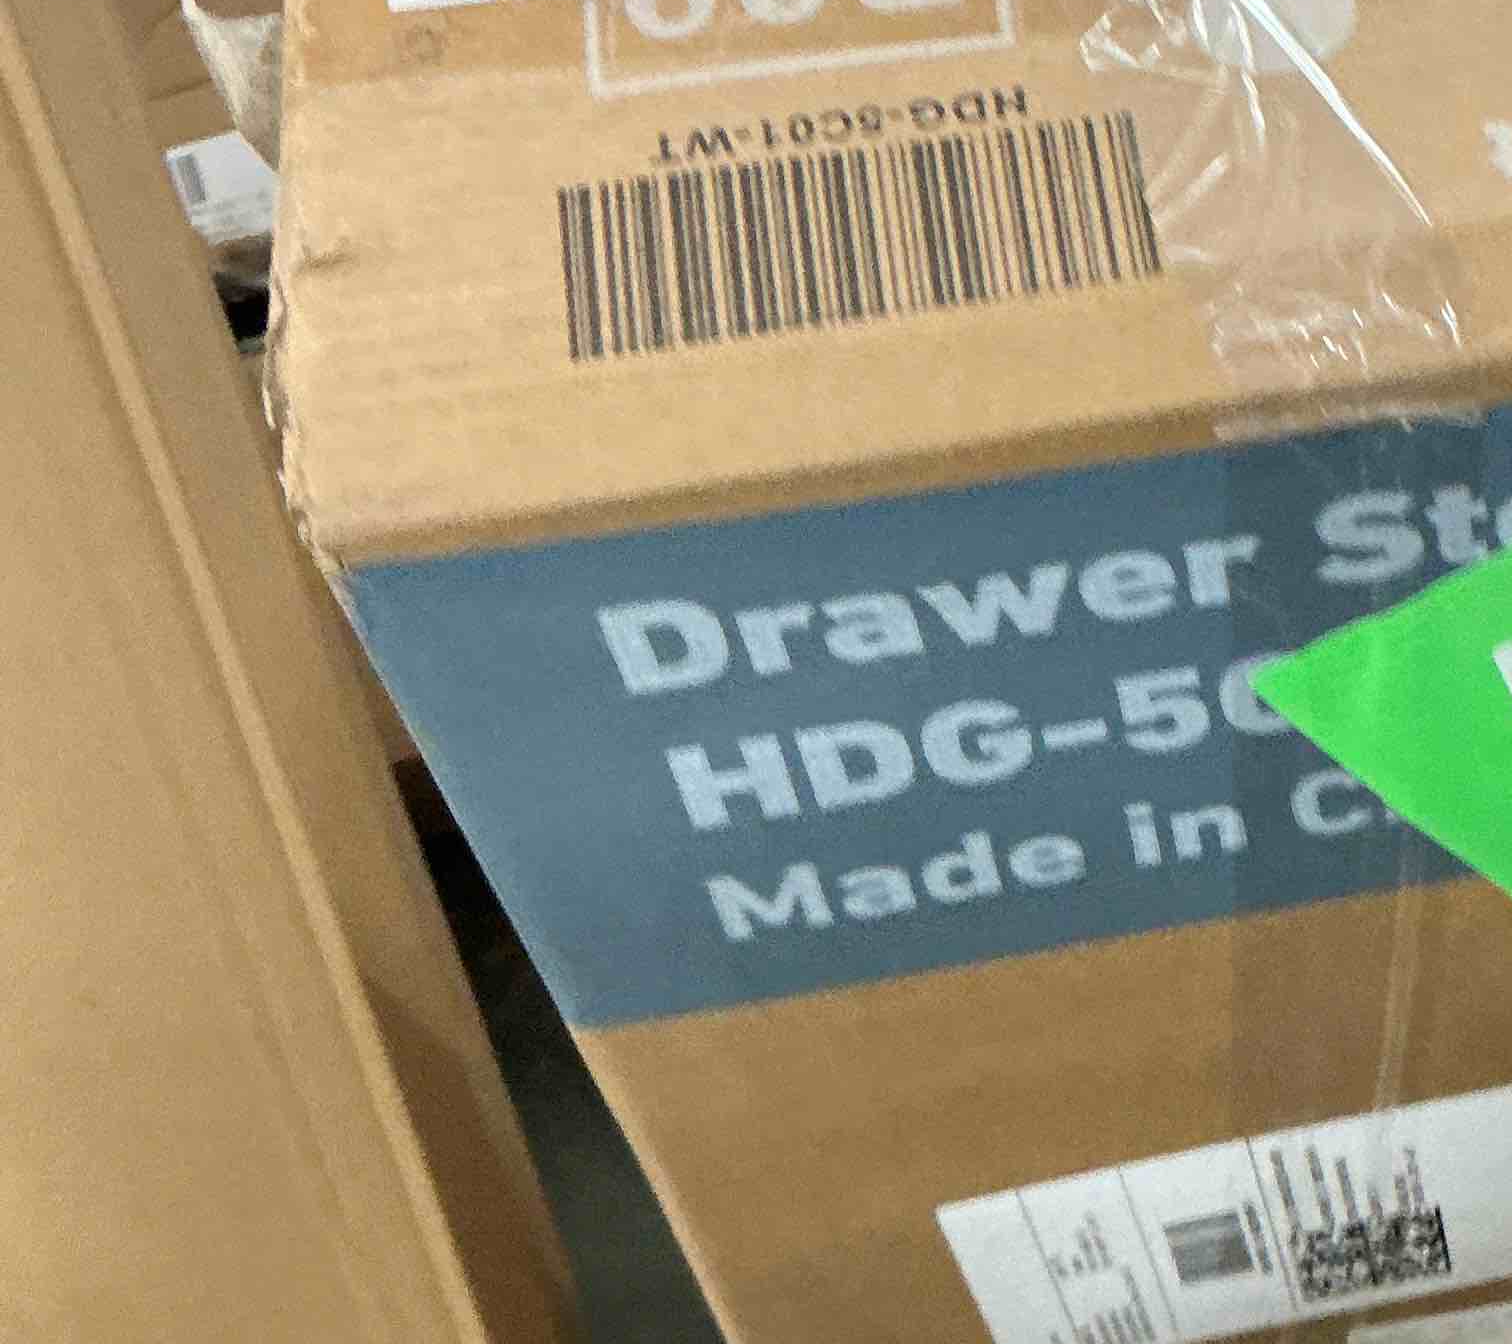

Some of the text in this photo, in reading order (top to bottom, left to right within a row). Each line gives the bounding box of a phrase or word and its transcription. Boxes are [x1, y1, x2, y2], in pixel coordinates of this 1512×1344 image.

[598, 533, 1260, 697] Drawer
[704, 830, 1087, 943] Made
[1125, 800, 1248, 870] in
